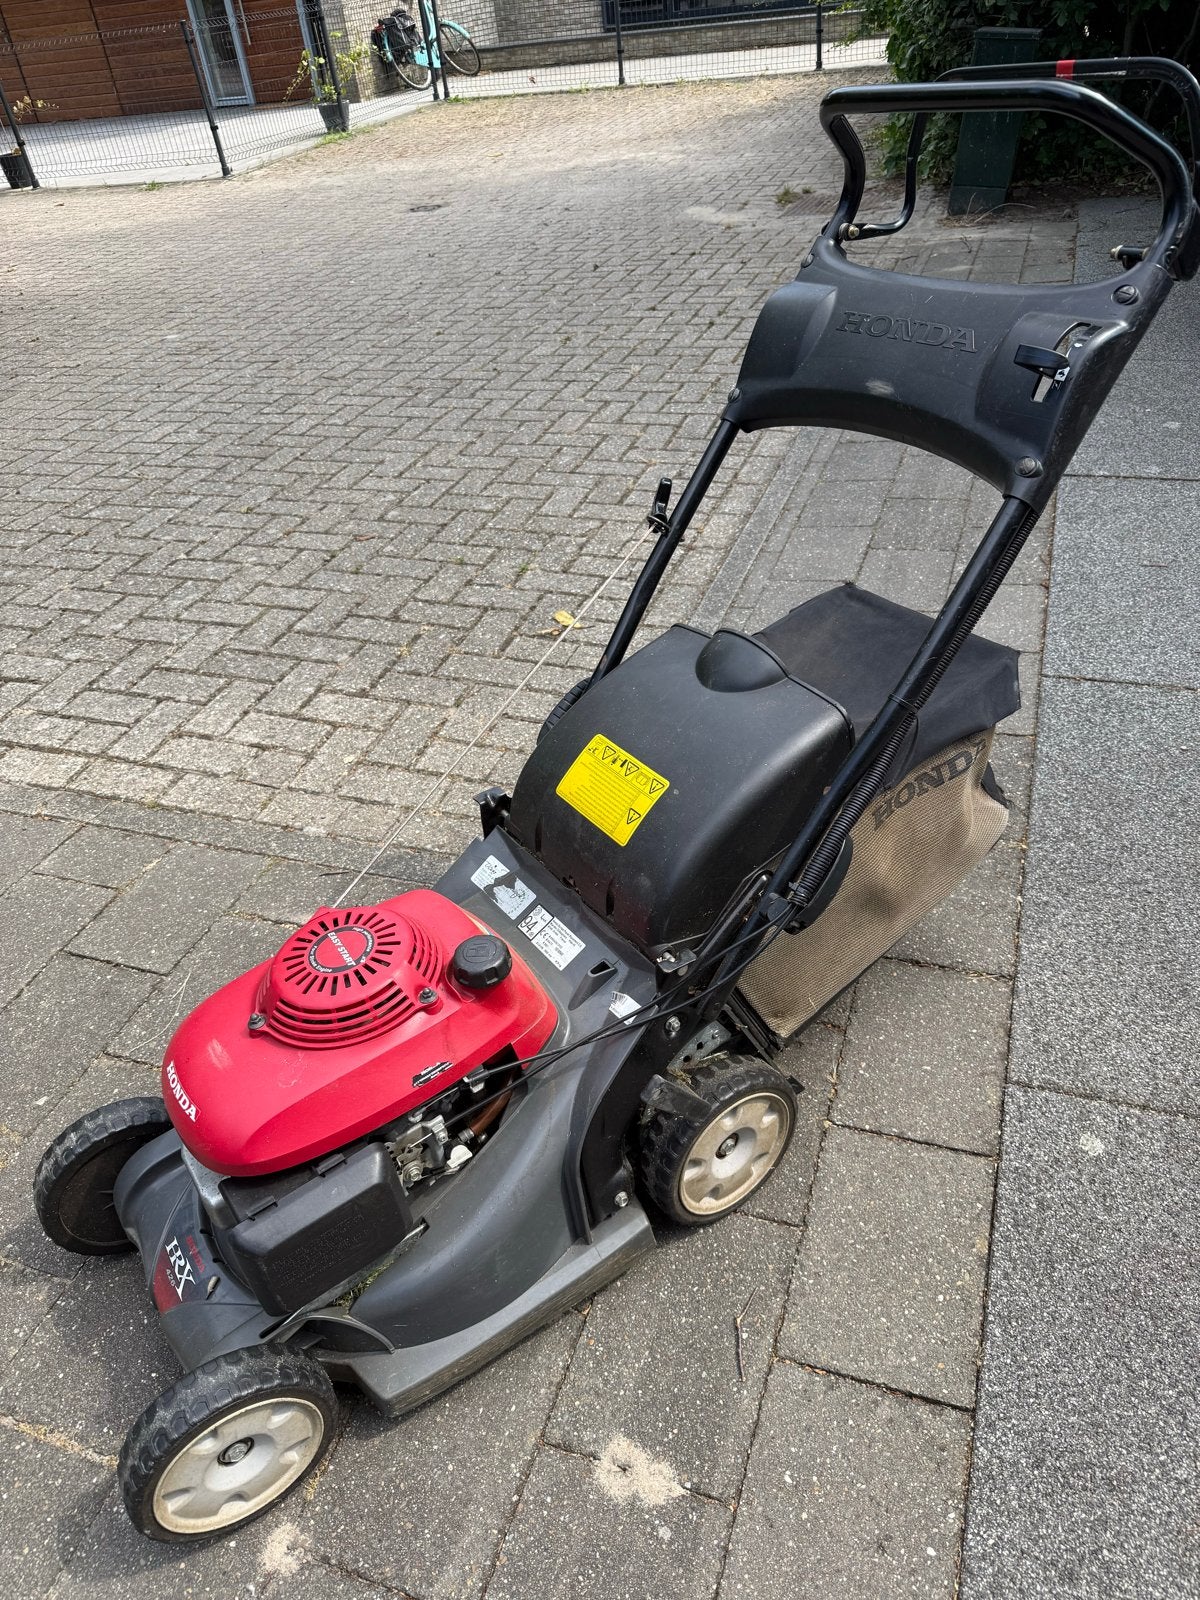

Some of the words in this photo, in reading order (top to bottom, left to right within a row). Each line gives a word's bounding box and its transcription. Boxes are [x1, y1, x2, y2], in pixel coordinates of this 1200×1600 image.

[836, 310, 978, 354] HONDA
[520, 915, 538, 933] 94
[327, 931, 343, 947] EASY
[337, 946, 356, 966] START
[166, 1060, 197, 1122] HONDA
[164, 1236, 196, 1302] HRX
